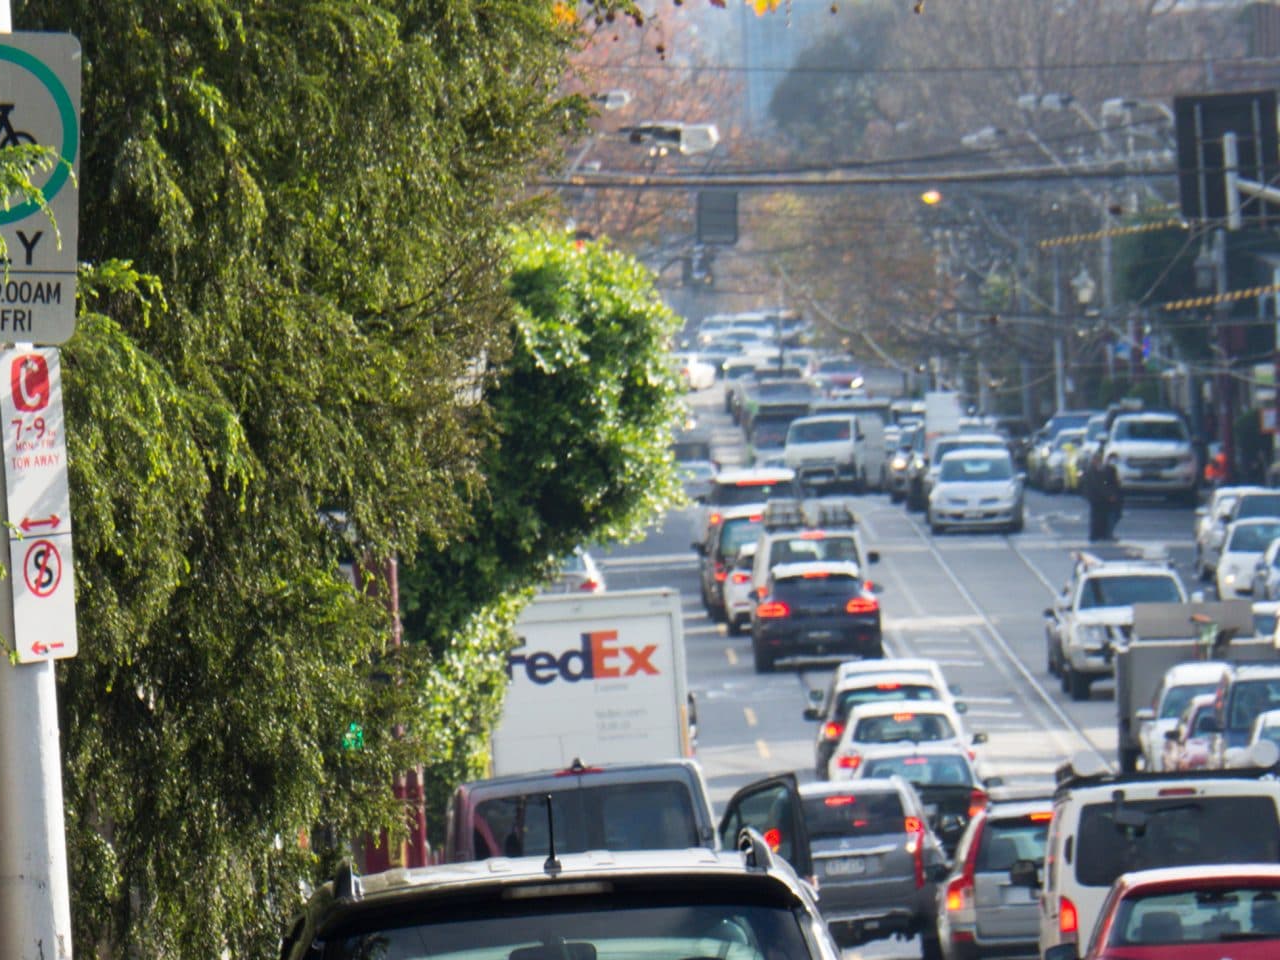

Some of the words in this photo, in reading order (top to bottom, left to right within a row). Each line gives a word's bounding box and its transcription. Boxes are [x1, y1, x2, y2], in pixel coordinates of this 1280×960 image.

[0, 309, 32, 332] FRI
[11, 416, 46, 441] 7-9
[11, 456, 31, 470] TOW
[34, 453, 60, 467] AWAY
